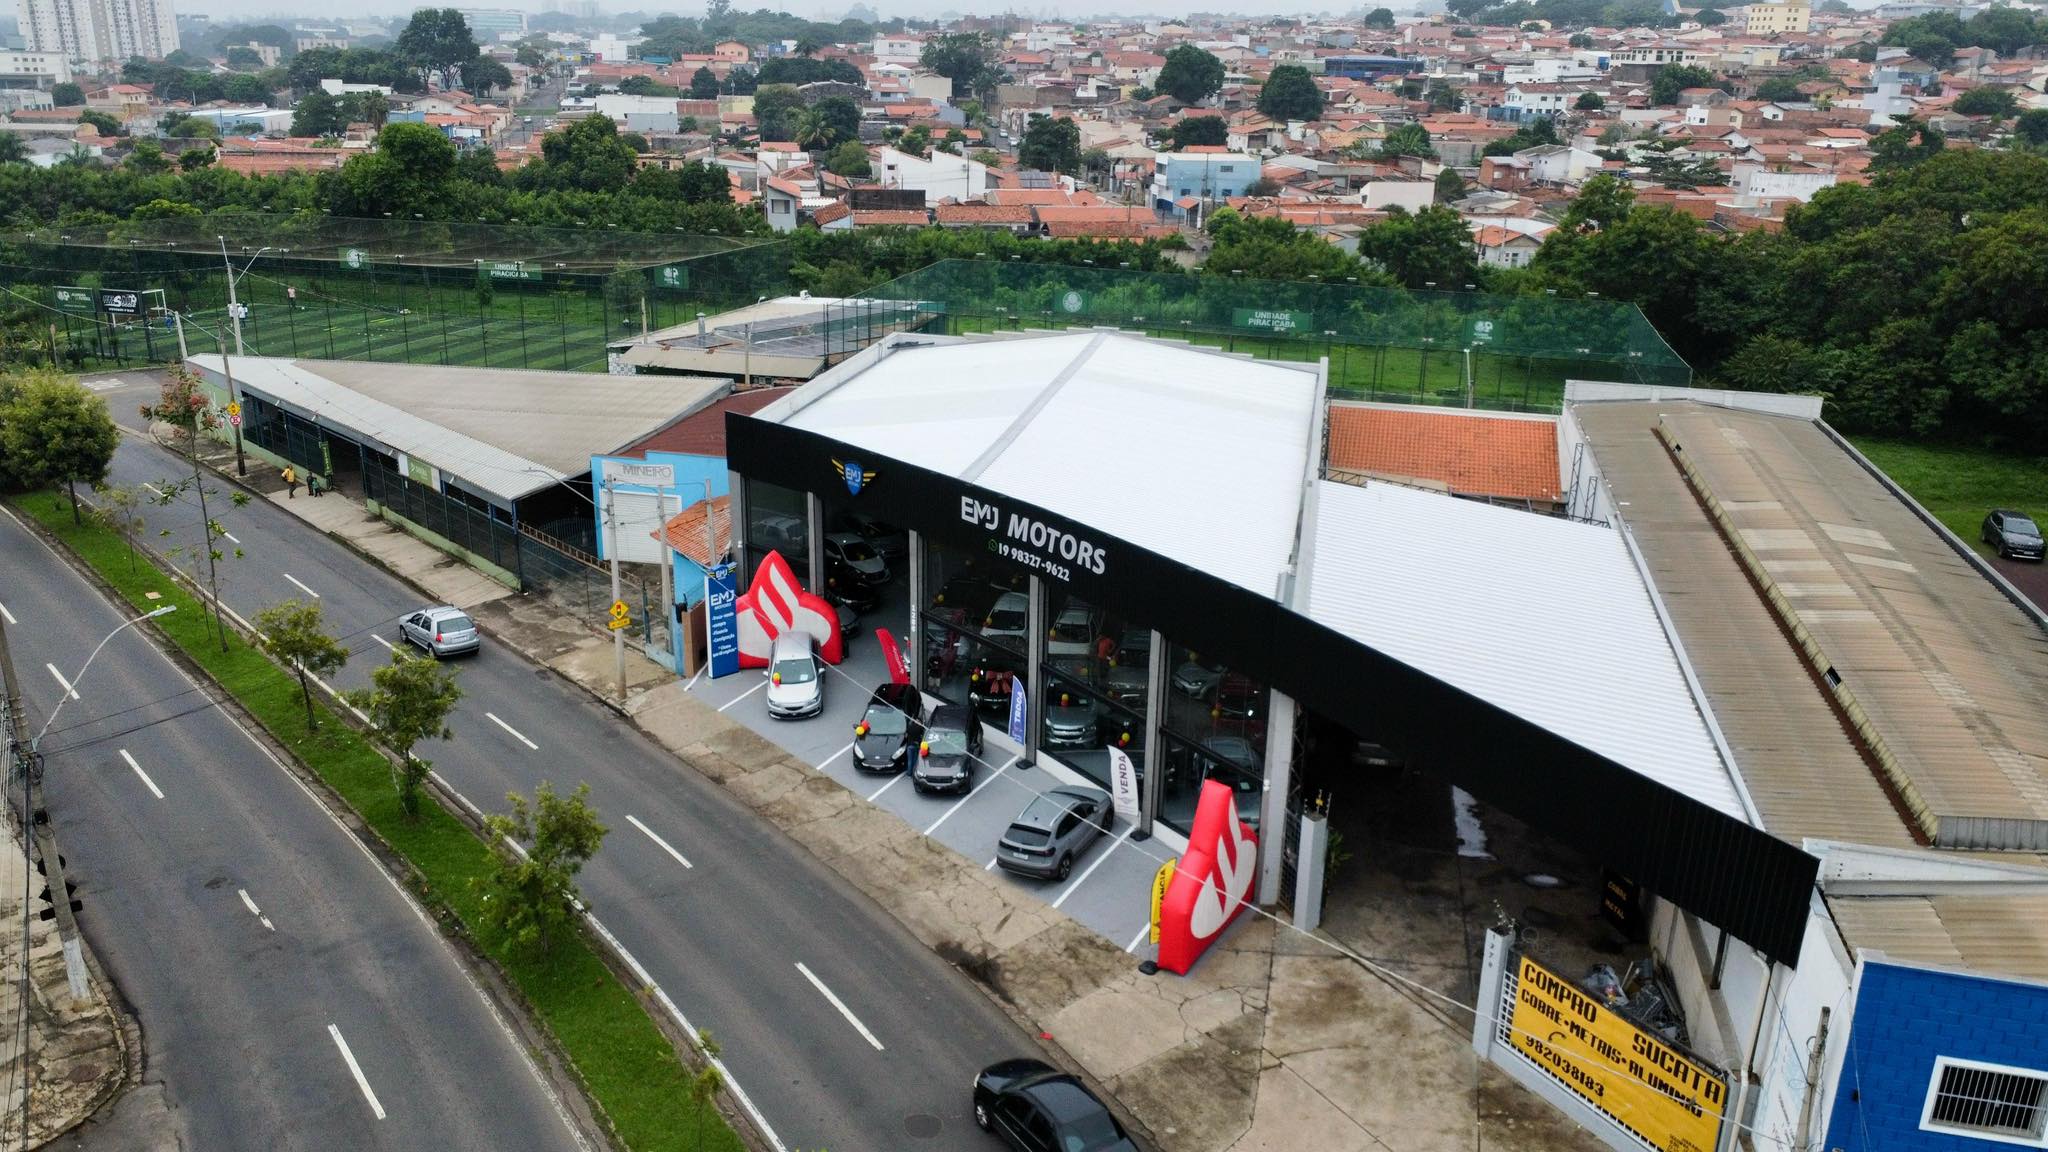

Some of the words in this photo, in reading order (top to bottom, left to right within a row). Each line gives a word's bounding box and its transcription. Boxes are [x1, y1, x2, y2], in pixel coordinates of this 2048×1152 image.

[1248, 318, 1296, 328] PIRACICABA
[1254, 311, 1291, 321] UNIDADE
[622, 464, 673, 478] MINEIRO
[961, 496, 999, 531] EMJ
[1007, 513, 1106, 575] MOTORS
[998, 542, 1009, 557] 19
[1011, 547, 1070, 582] 98327-9622
[710, 589, 735, 606] EMJ
[1118, 755, 1129, 794] VENDA
[1524, 964, 1597, 1023] COMPRO
[1632, 1032, 1721, 1105] SUCATA
[1525, 1034, 1605, 1097] 982038183
